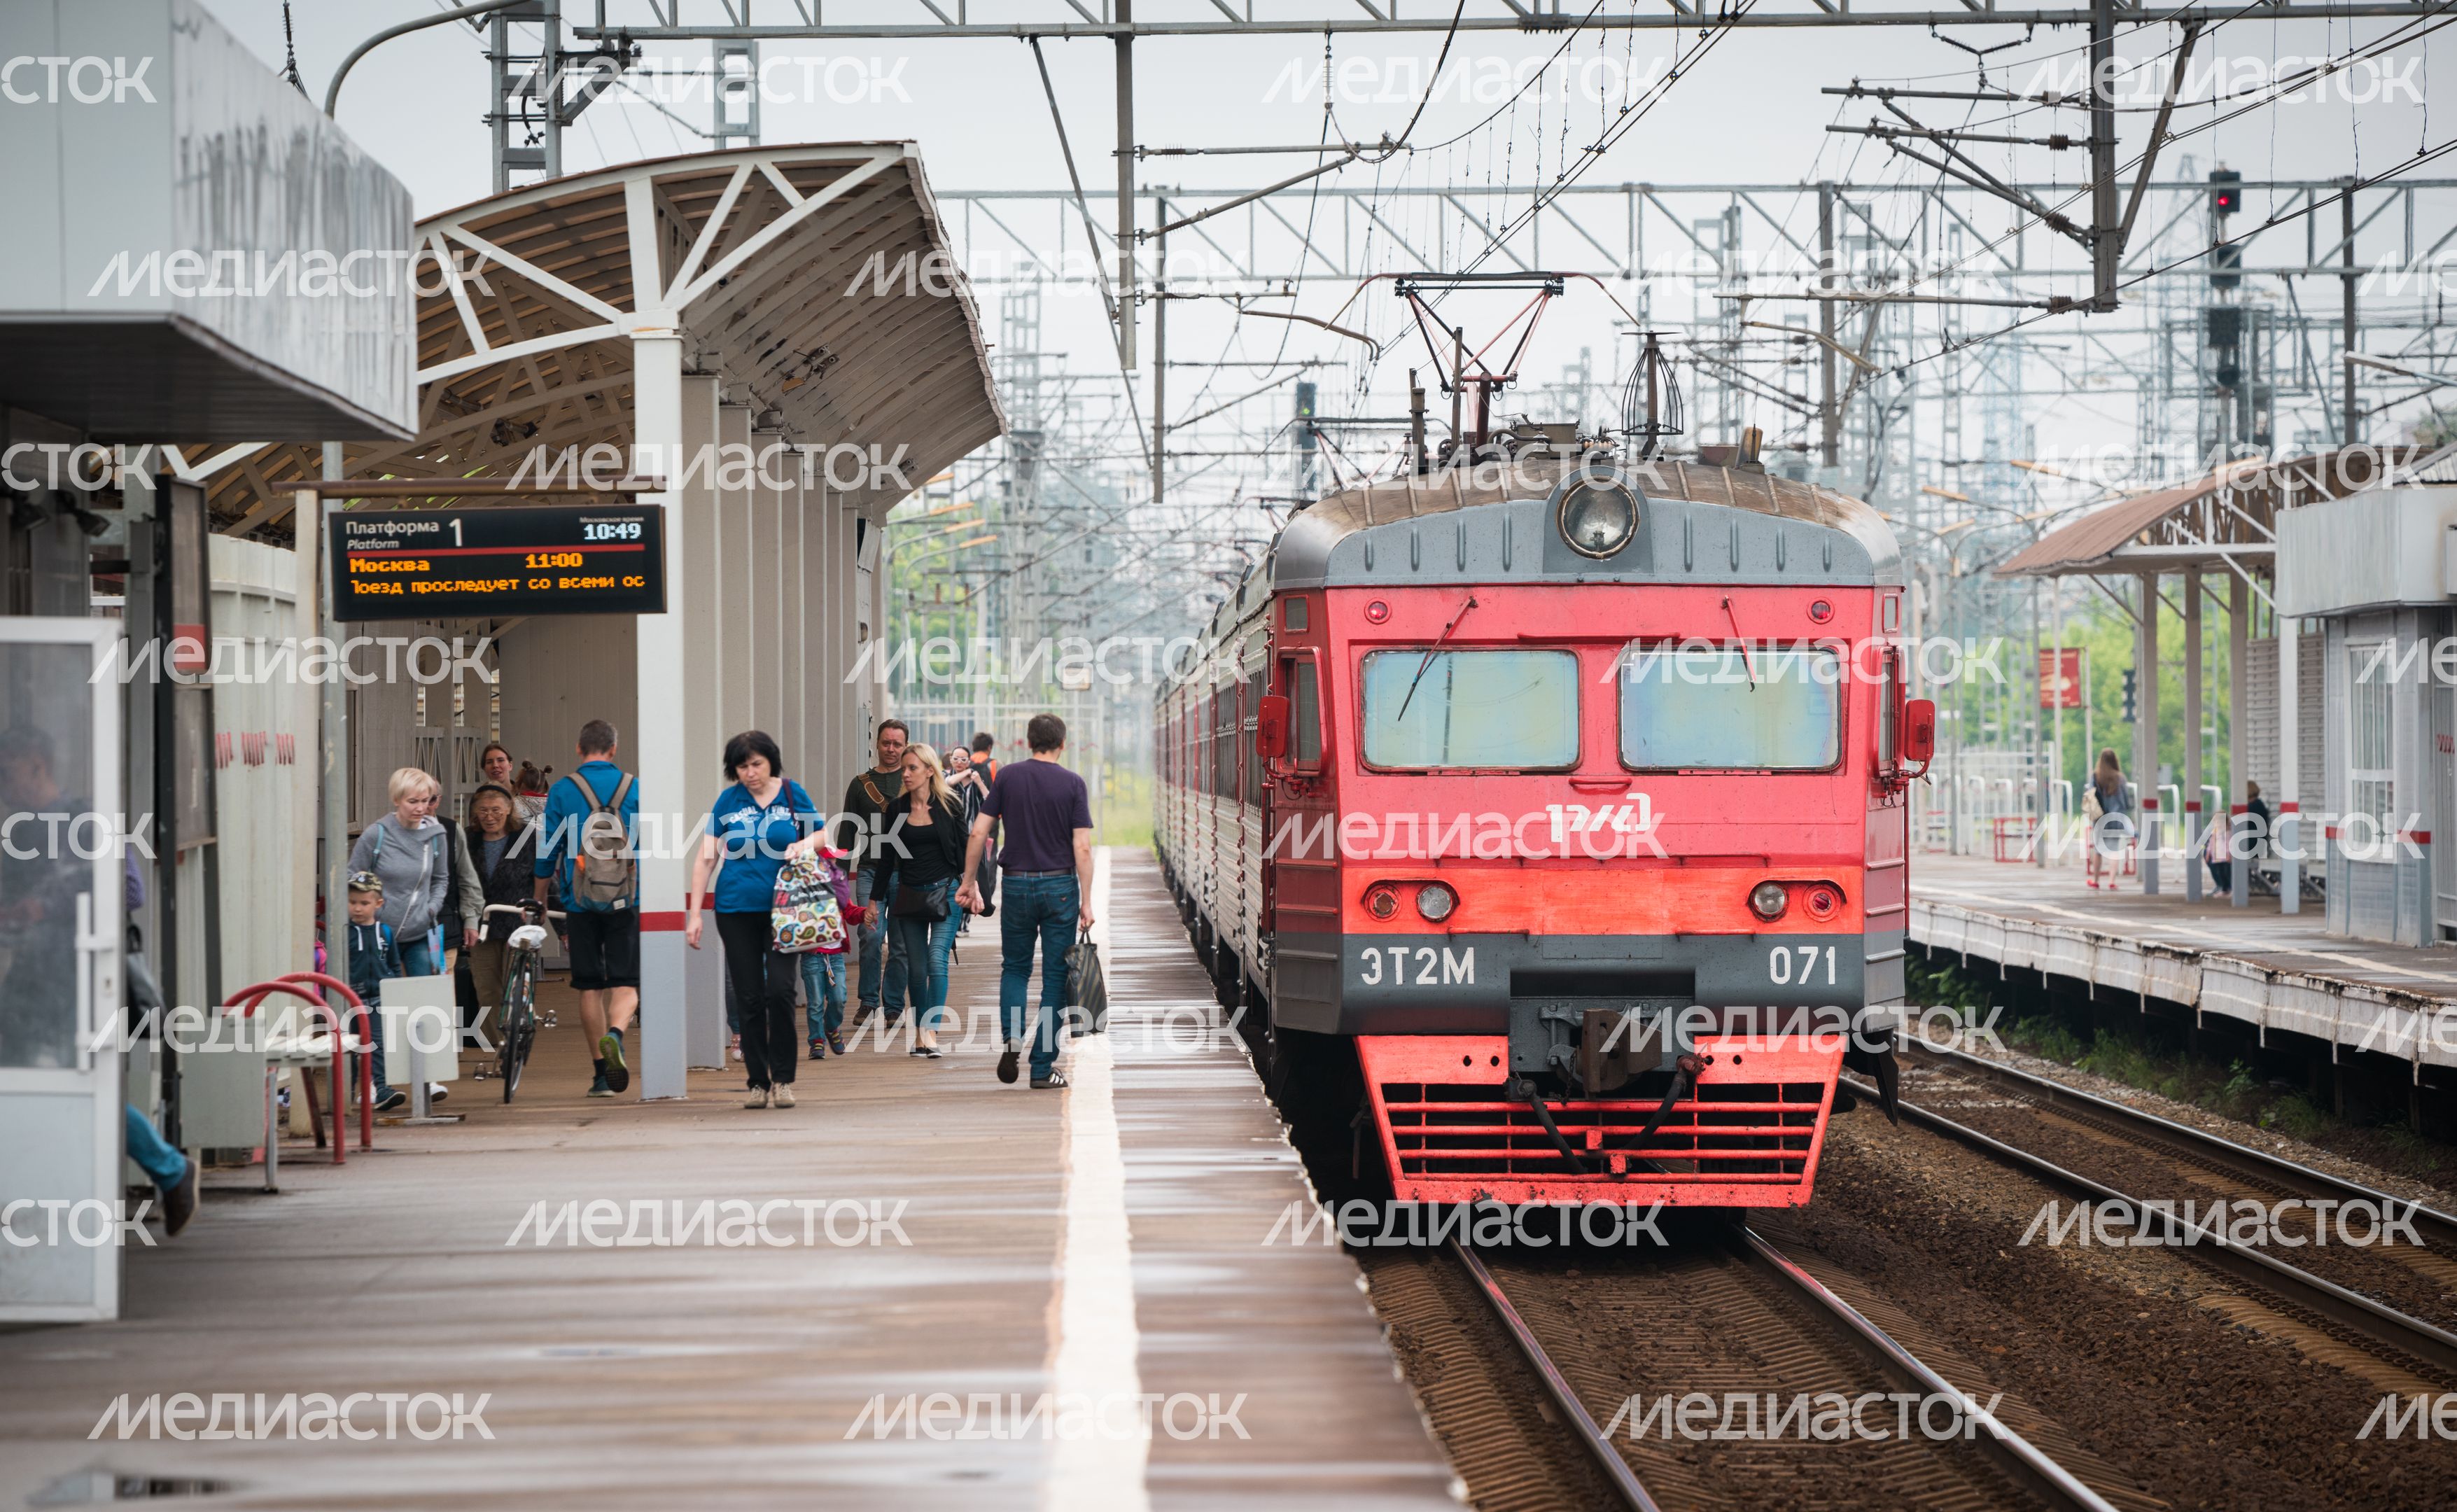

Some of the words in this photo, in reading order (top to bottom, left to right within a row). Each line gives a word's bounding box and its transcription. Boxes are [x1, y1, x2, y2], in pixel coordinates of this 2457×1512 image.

[346, 520, 440, 536] Платформа
[449, 518, 462, 547] 1
[584, 523, 642, 540] 10:49
[347, 538, 400, 550] Platform
[350, 558, 430, 573] Москва
[526, 552, 582, 568] 11:00
[411, 579, 520, 594] проследует
[528, 578, 551, 589] со
[559, 577, 615, 588] всеми
[622, 575, 645, 587] ос
[1361, 947, 1474, 985] ЭТ2М
[1770, 946, 1835, 984] 071
